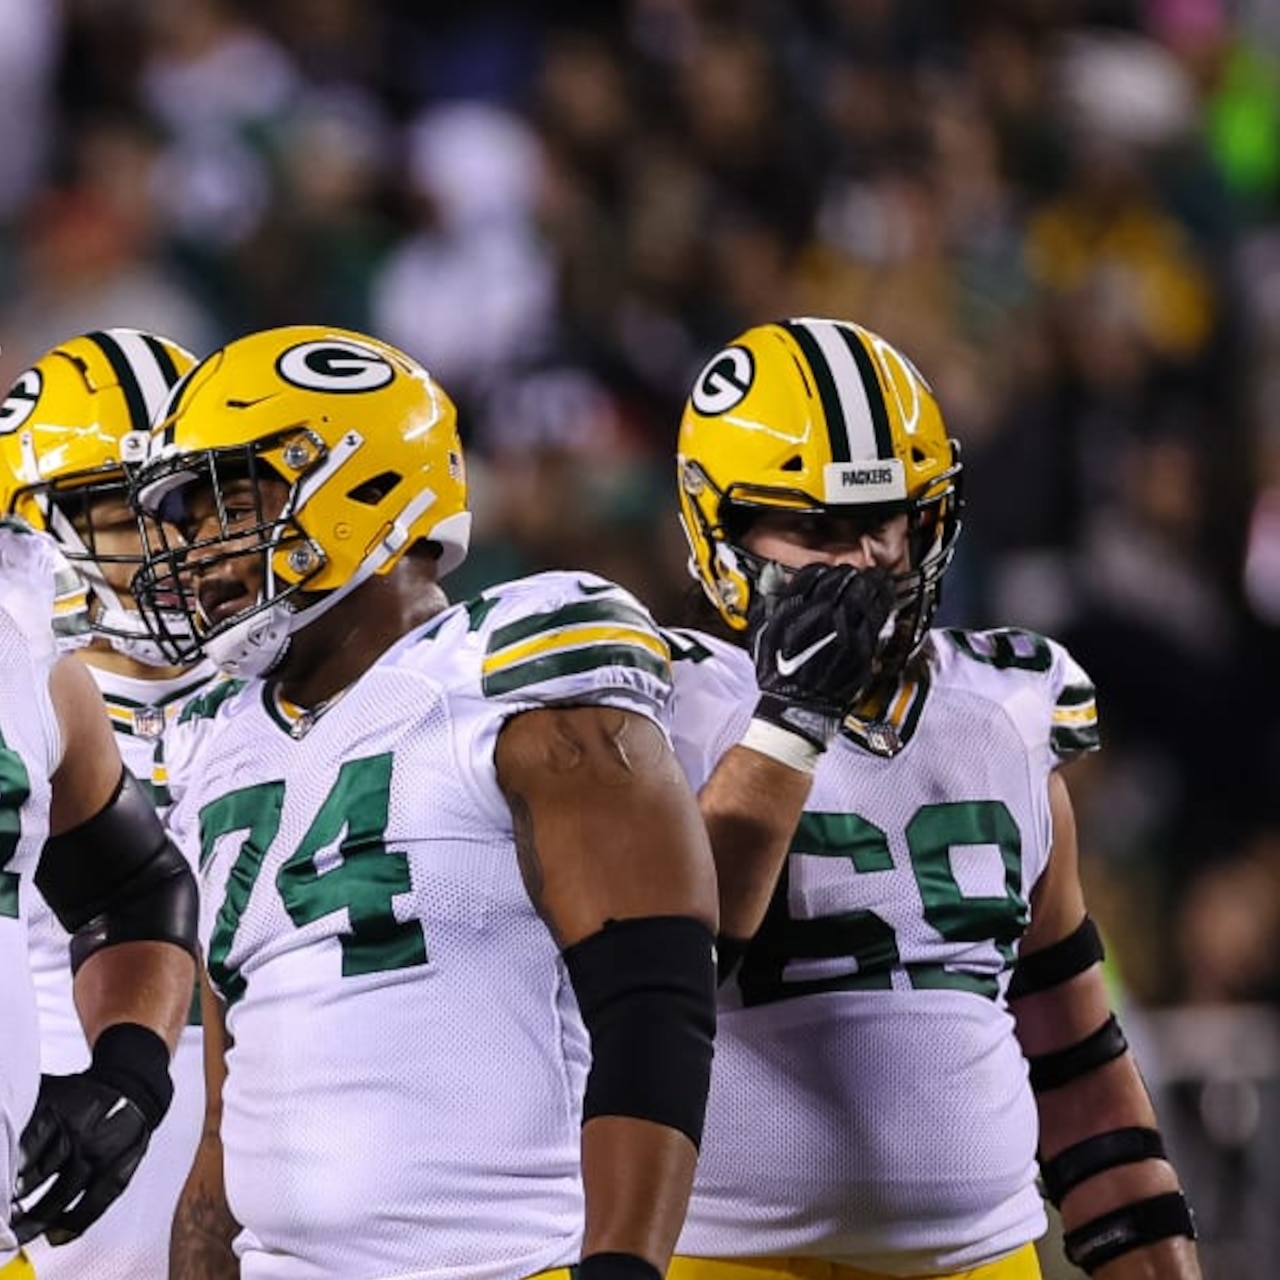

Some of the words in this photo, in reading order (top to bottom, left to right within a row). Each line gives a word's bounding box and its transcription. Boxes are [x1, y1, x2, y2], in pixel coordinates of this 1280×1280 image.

[275, 341, 395, 393] G
[691, 345, 754, 417] G
[842, 467, 893, 487] PACKERS
[199, 752, 428, 1002] 74
[740, 799, 1029, 1000] 69
